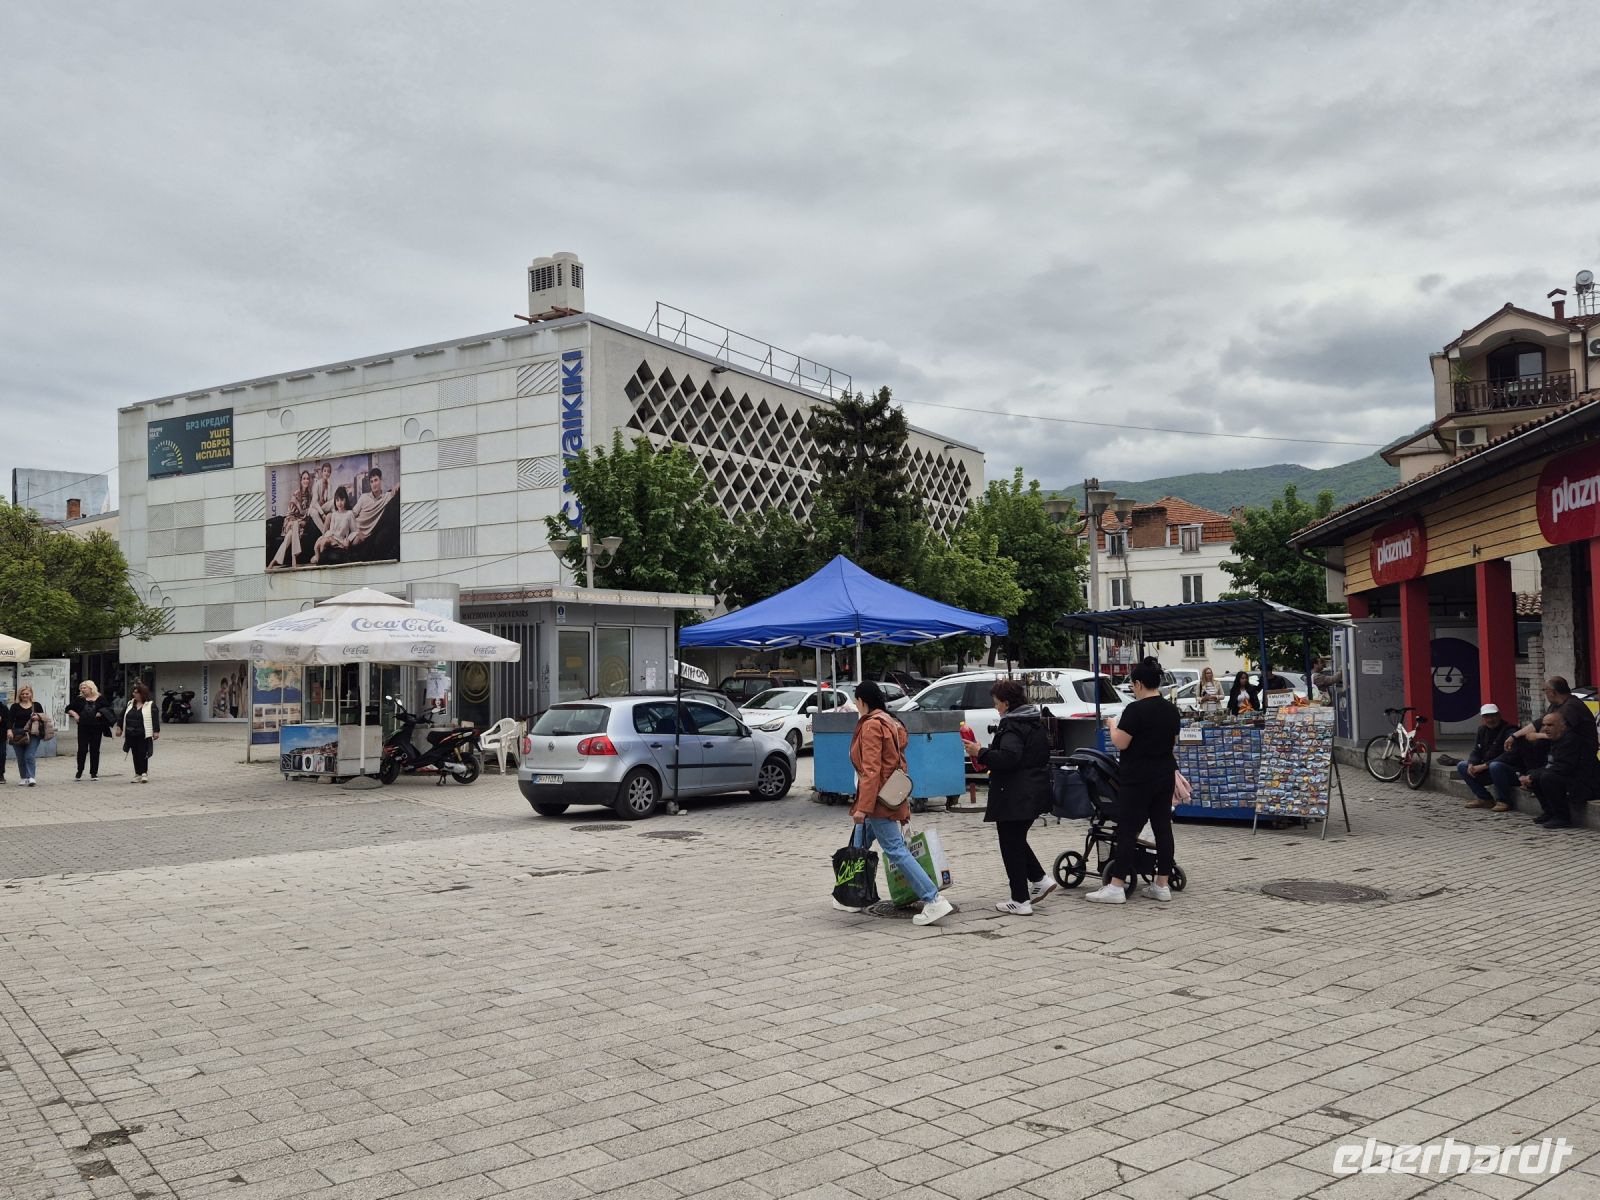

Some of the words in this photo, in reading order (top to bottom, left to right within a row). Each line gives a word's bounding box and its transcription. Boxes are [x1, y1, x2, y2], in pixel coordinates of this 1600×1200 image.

[185, 420, 200, 431] БРЗ
[200, 415, 230, 429] КРЕДИТ
[209, 428, 230, 439] УШТЕ
[201, 438, 231, 450] ПОБРЗА
[195, 448, 231, 461] ИСПЛАТА
[1377, 536, 1413, 571] plazma
[351, 616, 448, 633] Coca-Cola
